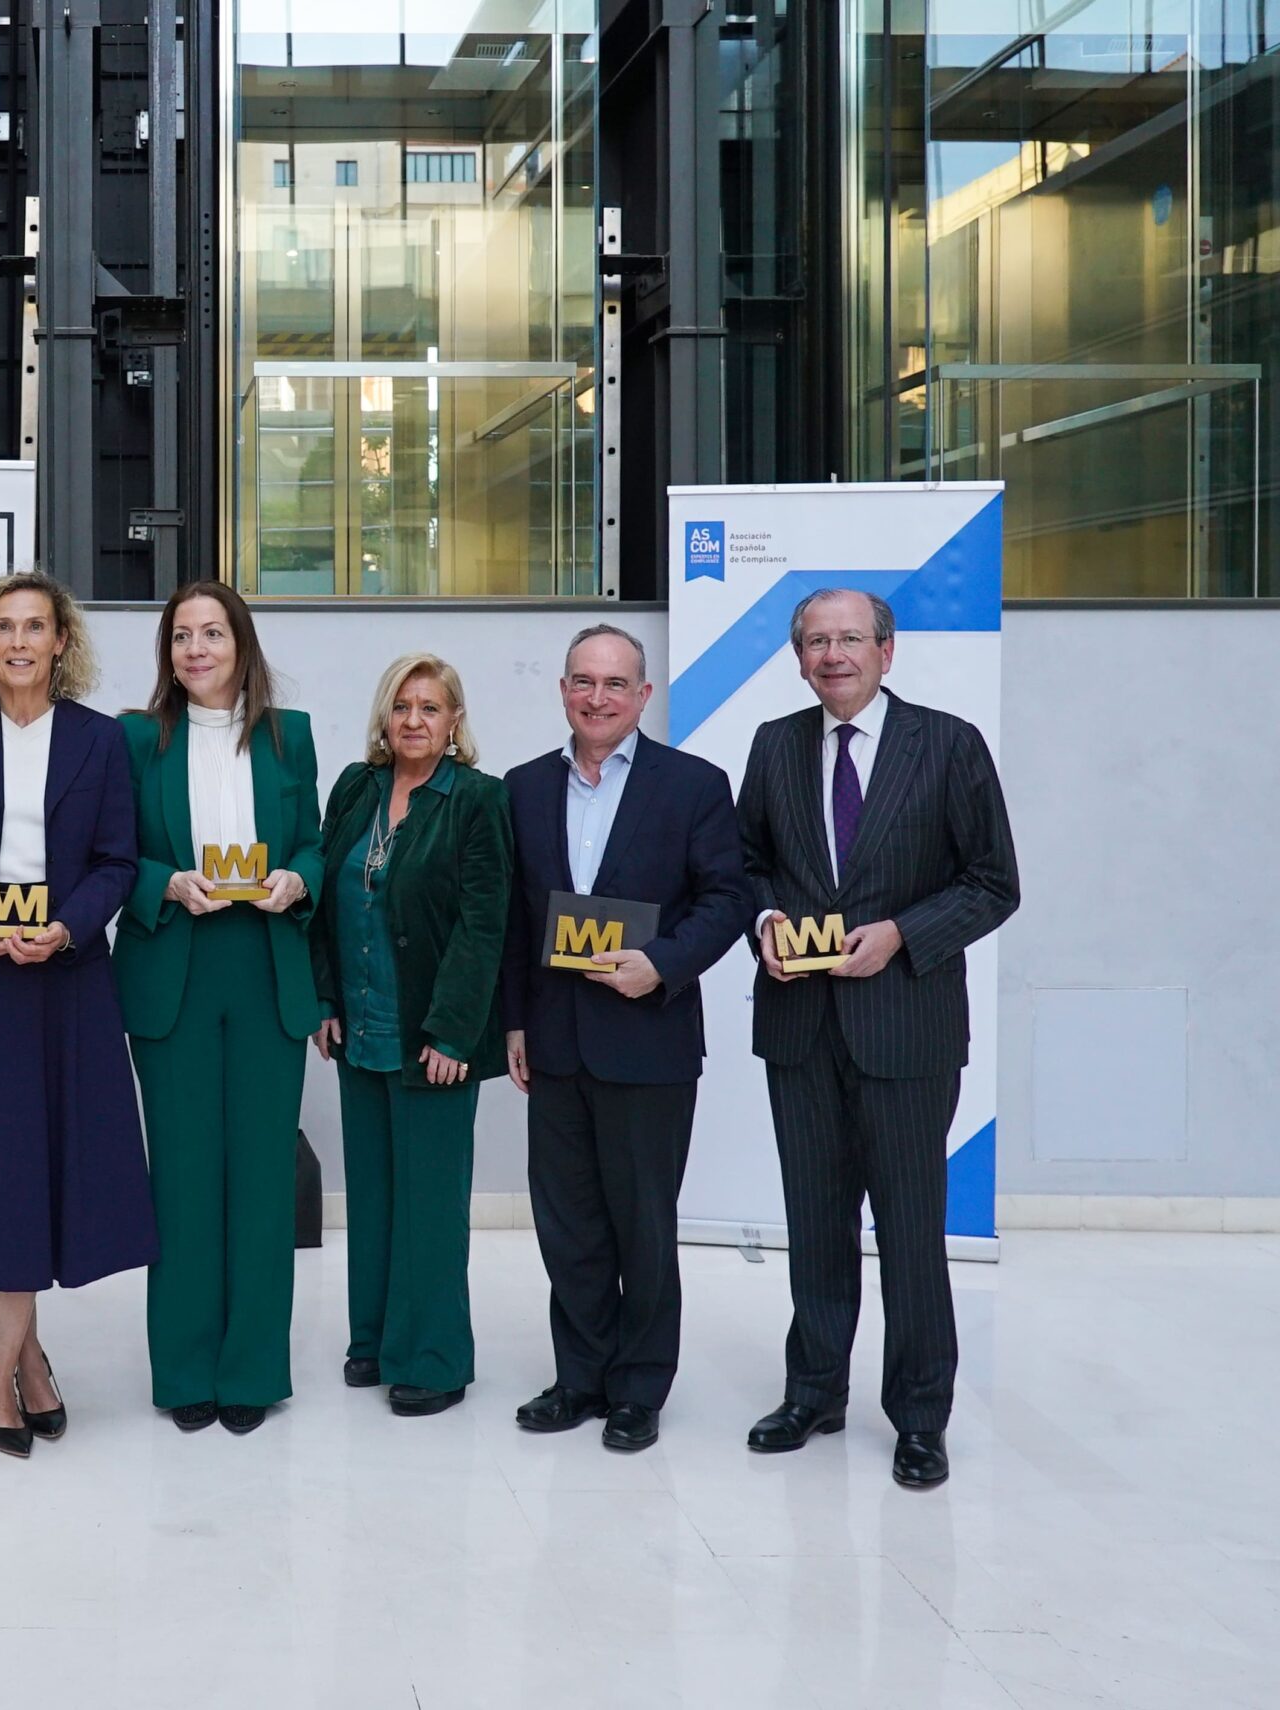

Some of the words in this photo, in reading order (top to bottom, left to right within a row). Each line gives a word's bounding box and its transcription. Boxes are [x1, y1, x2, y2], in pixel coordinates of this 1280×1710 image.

[691, 528, 710, 540] AS
[730, 532, 772, 540] Asociación
[690, 540, 720, 553] COM
[729, 544, 766, 552] Española
[741, 556, 787, 564] Compliance
